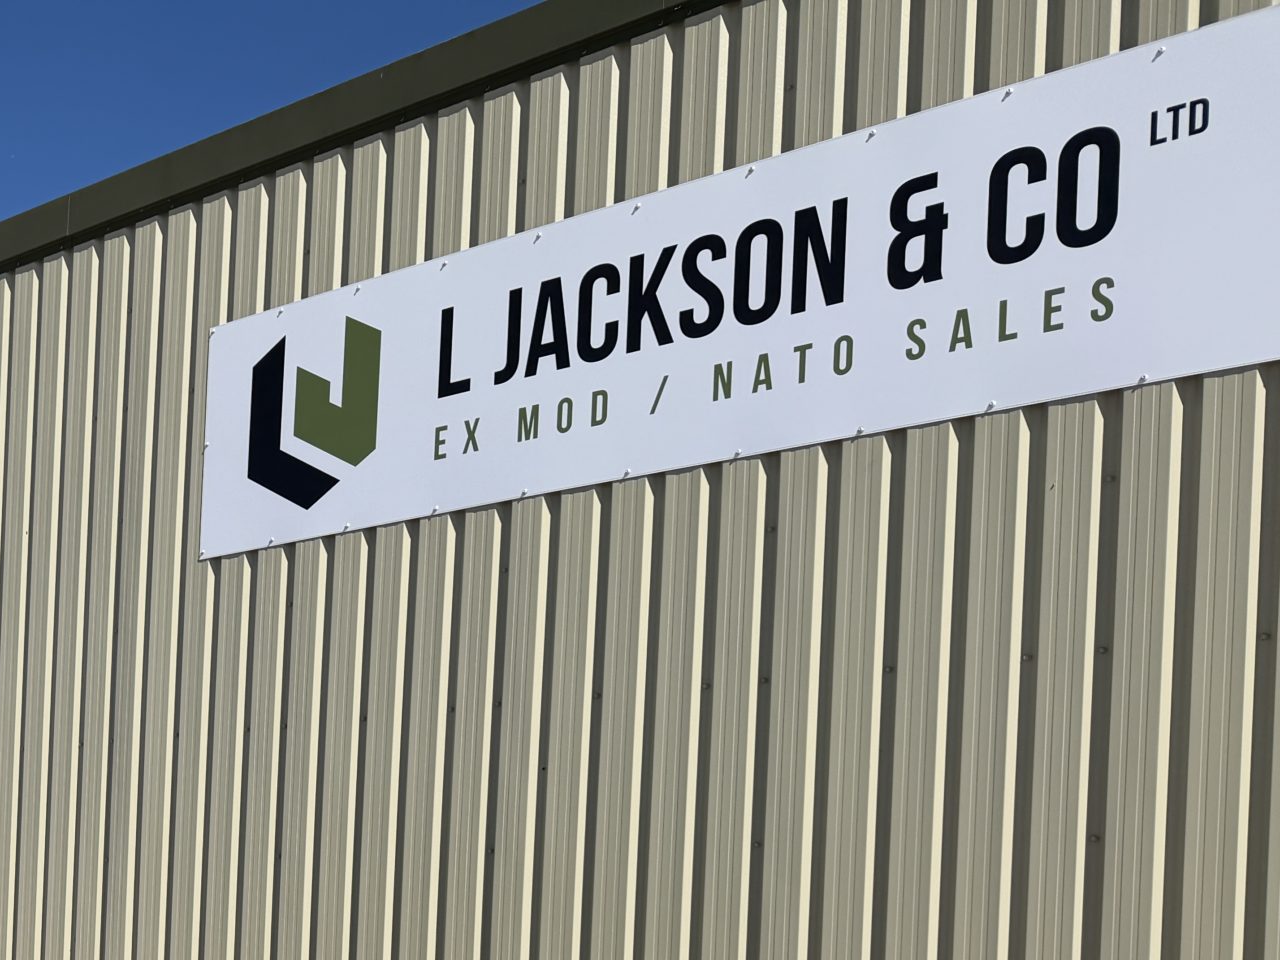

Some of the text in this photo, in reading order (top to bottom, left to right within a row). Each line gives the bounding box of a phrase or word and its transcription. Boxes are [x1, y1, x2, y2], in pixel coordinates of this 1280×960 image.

[1148, 97, 1210, 147] LTD
[437, 126, 1121, 399] L JACKSON & CO
[432, 416, 481, 461] EX
[516, 388, 610, 443] MOD
[711, 333, 855, 402] NATO
[904, 275, 1116, 361] SALES
